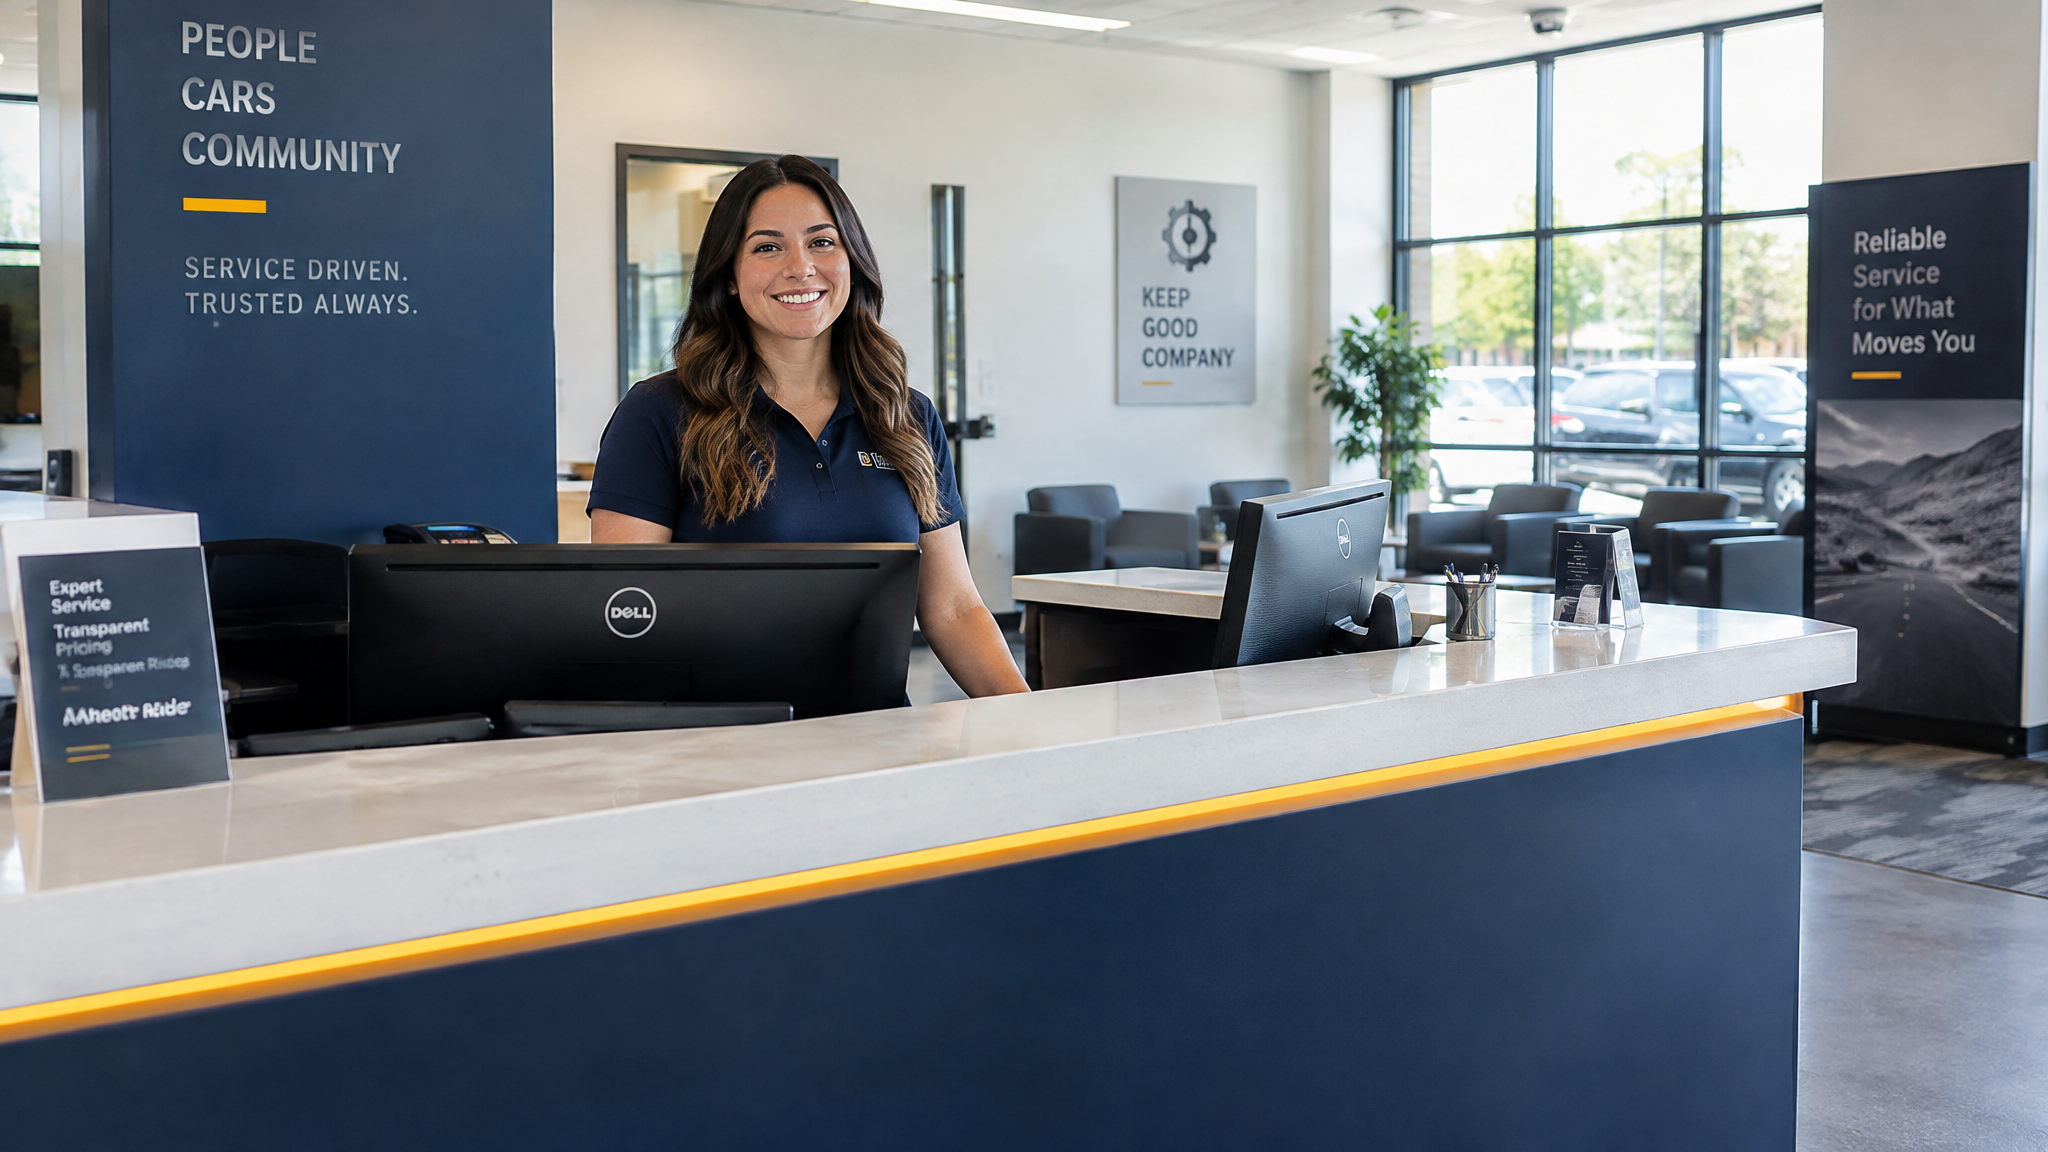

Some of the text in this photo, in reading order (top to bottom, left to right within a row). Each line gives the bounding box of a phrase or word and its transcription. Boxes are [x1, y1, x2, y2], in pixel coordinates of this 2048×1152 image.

[181, 21, 317, 64] PEOPLE
[181, 76, 276, 115] CARS
[182, 131, 402, 174] COMMUNITY
[1853, 225, 1947, 255] Reliable
[185, 256, 409, 282] SERVICE DRIVEN.
[1853, 261, 1941, 289] Service
[185, 292, 418, 315] TRUSTED ALWAYS.
[1142, 286, 1190, 308] KEEP
[1853, 295, 1956, 322] for What
[1142, 317, 1198, 338] GOOD
[1852, 329, 1976, 355] Moves You
[1142, 347, 1235, 368] COMPANY
[50, 578, 104, 597] Expert
[51, 596, 112, 615] Service
[610, 606, 652, 619] DELL
[53, 617, 150, 640] Transparent
